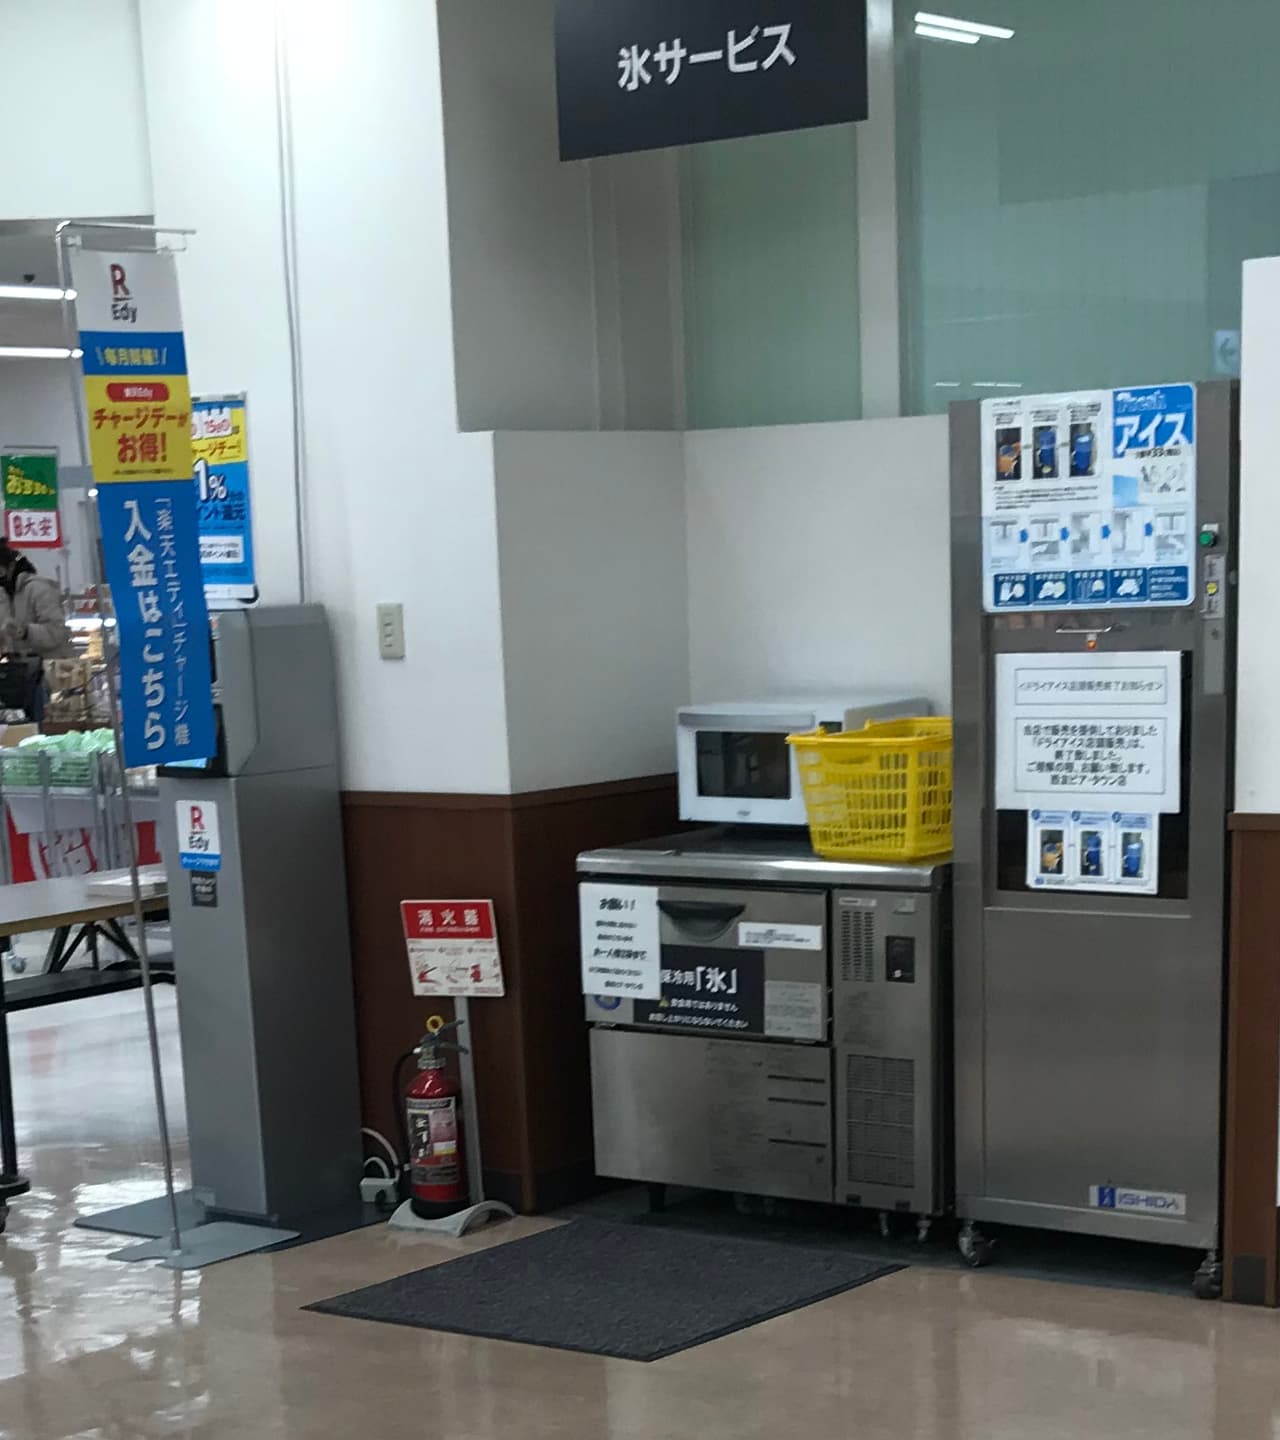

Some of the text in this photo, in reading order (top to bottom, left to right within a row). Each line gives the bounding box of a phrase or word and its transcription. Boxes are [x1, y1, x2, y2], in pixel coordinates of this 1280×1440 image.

[618, 23, 797, 91] 氷サービス
[110, 264, 130, 295] R
[111, 303, 137, 323] Edy
[23, 517, 53, 537] 大安
[123, 500, 166, 751] 入金はこちら
[190, 805, 205, 831] R
[417, 908, 479, 926] 消火器
